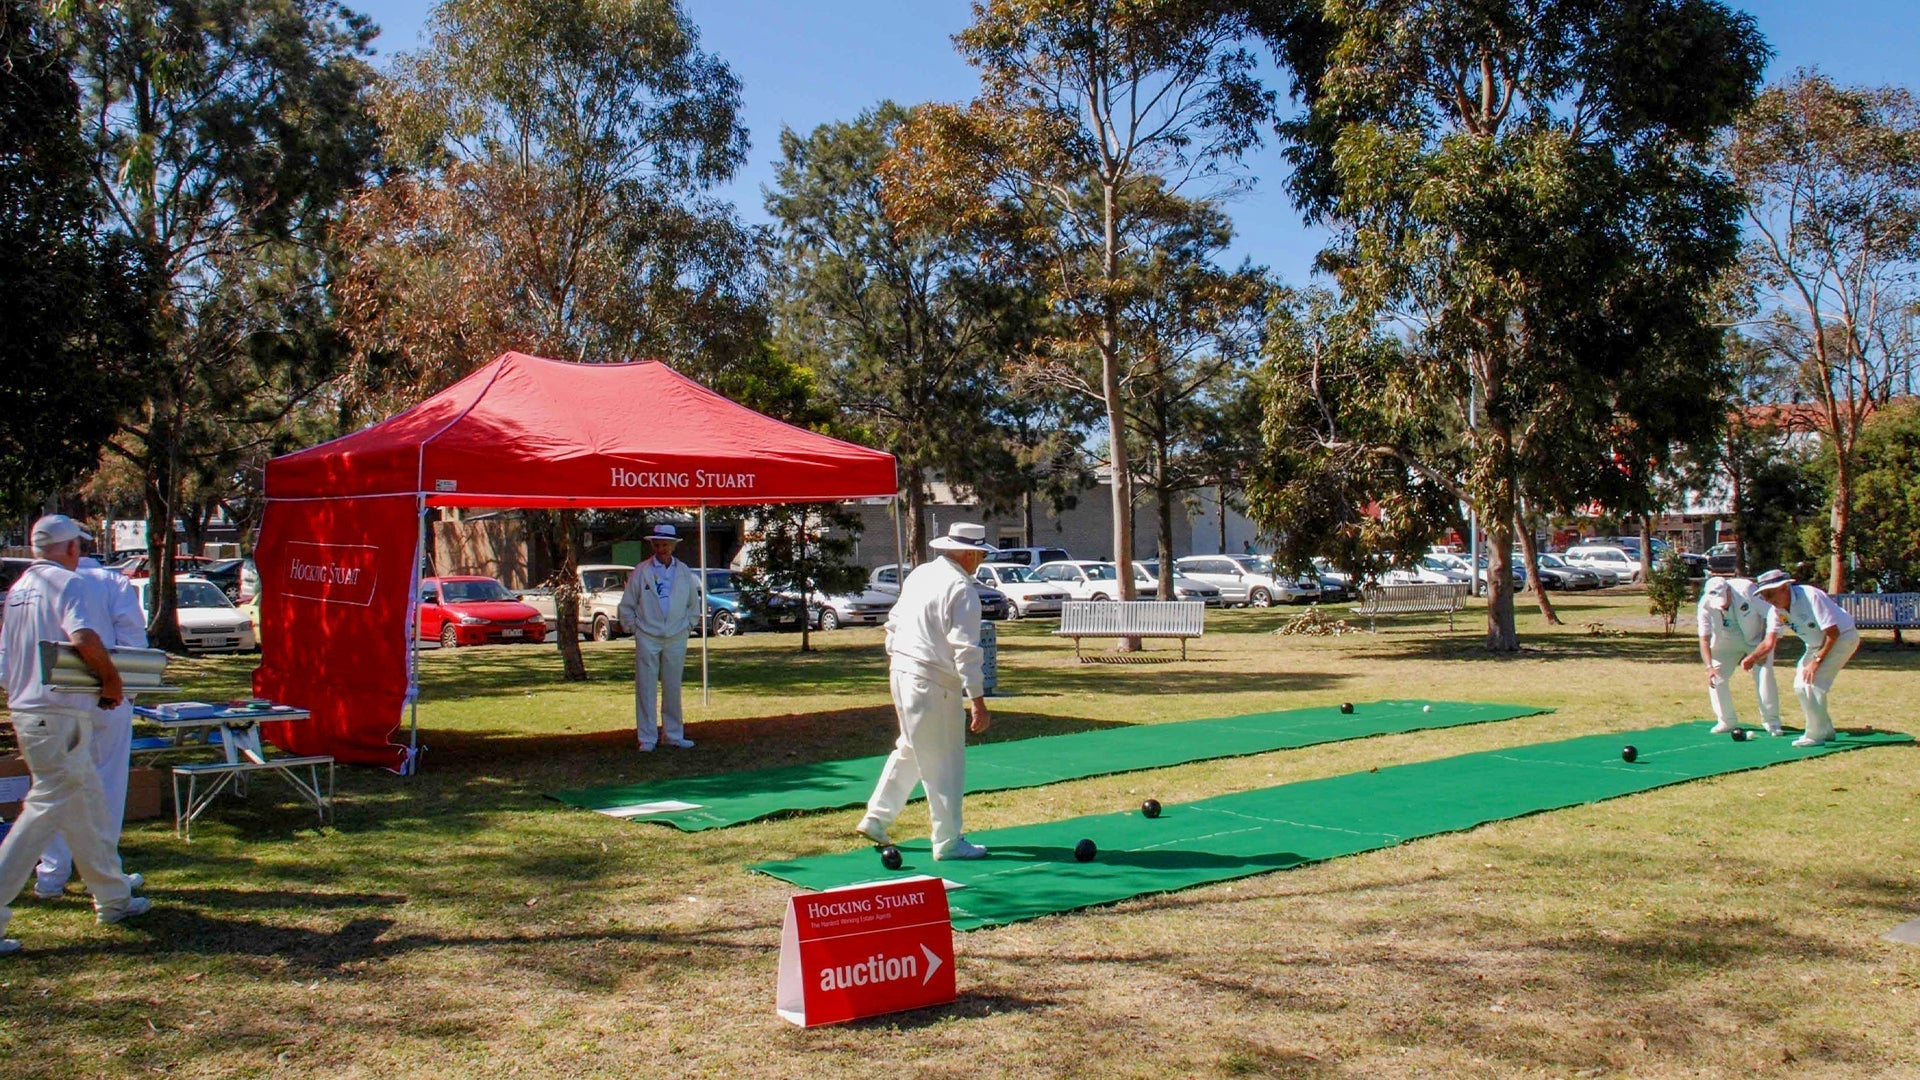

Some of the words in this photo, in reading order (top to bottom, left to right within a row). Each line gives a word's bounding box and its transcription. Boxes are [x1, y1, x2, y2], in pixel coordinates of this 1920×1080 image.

[611, 468, 690, 488] HOCKING
[696, 469, 756, 488] STUART
[808, 899, 872, 919] HOCKING
[875, 892, 925, 910] STUART
[820, 953, 917, 992] auction
